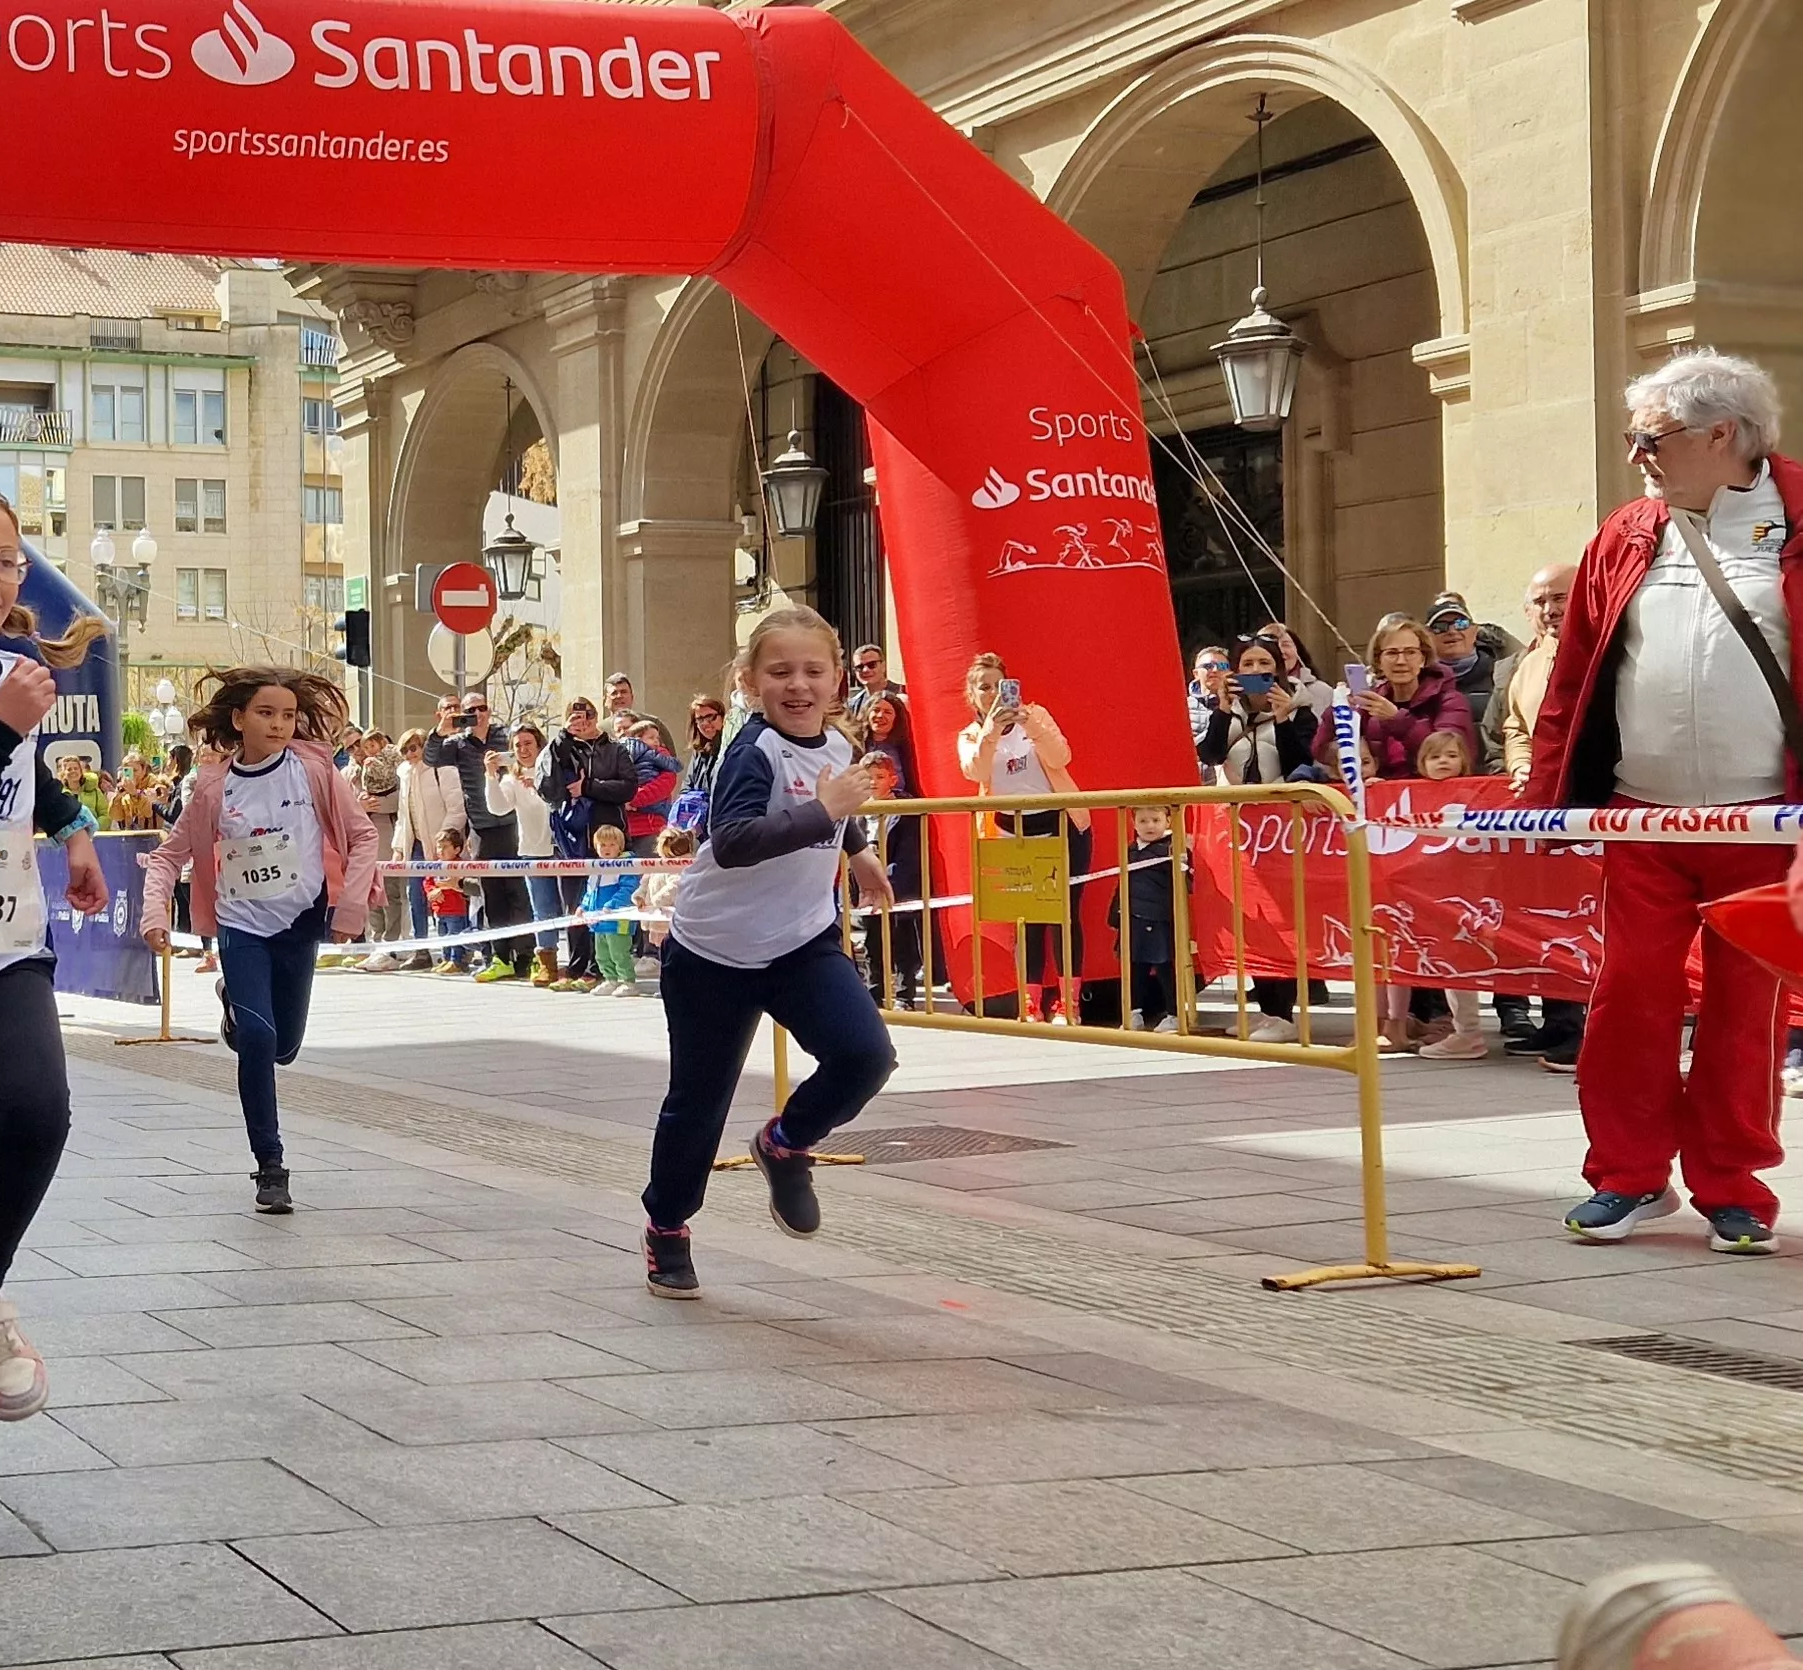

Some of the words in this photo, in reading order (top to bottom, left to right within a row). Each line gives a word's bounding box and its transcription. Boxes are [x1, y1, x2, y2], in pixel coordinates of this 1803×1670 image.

[310, 19, 720, 101] Santander
[173, 128, 449, 163] sportssantander.es
[1028, 406, 1133, 447] Sports
[1025, 465, 1158, 508] Santande
[1588, 808, 1634, 832] NO
[1640, 807, 1754, 832] PASAR
[242, 864, 282, 885] 1035
